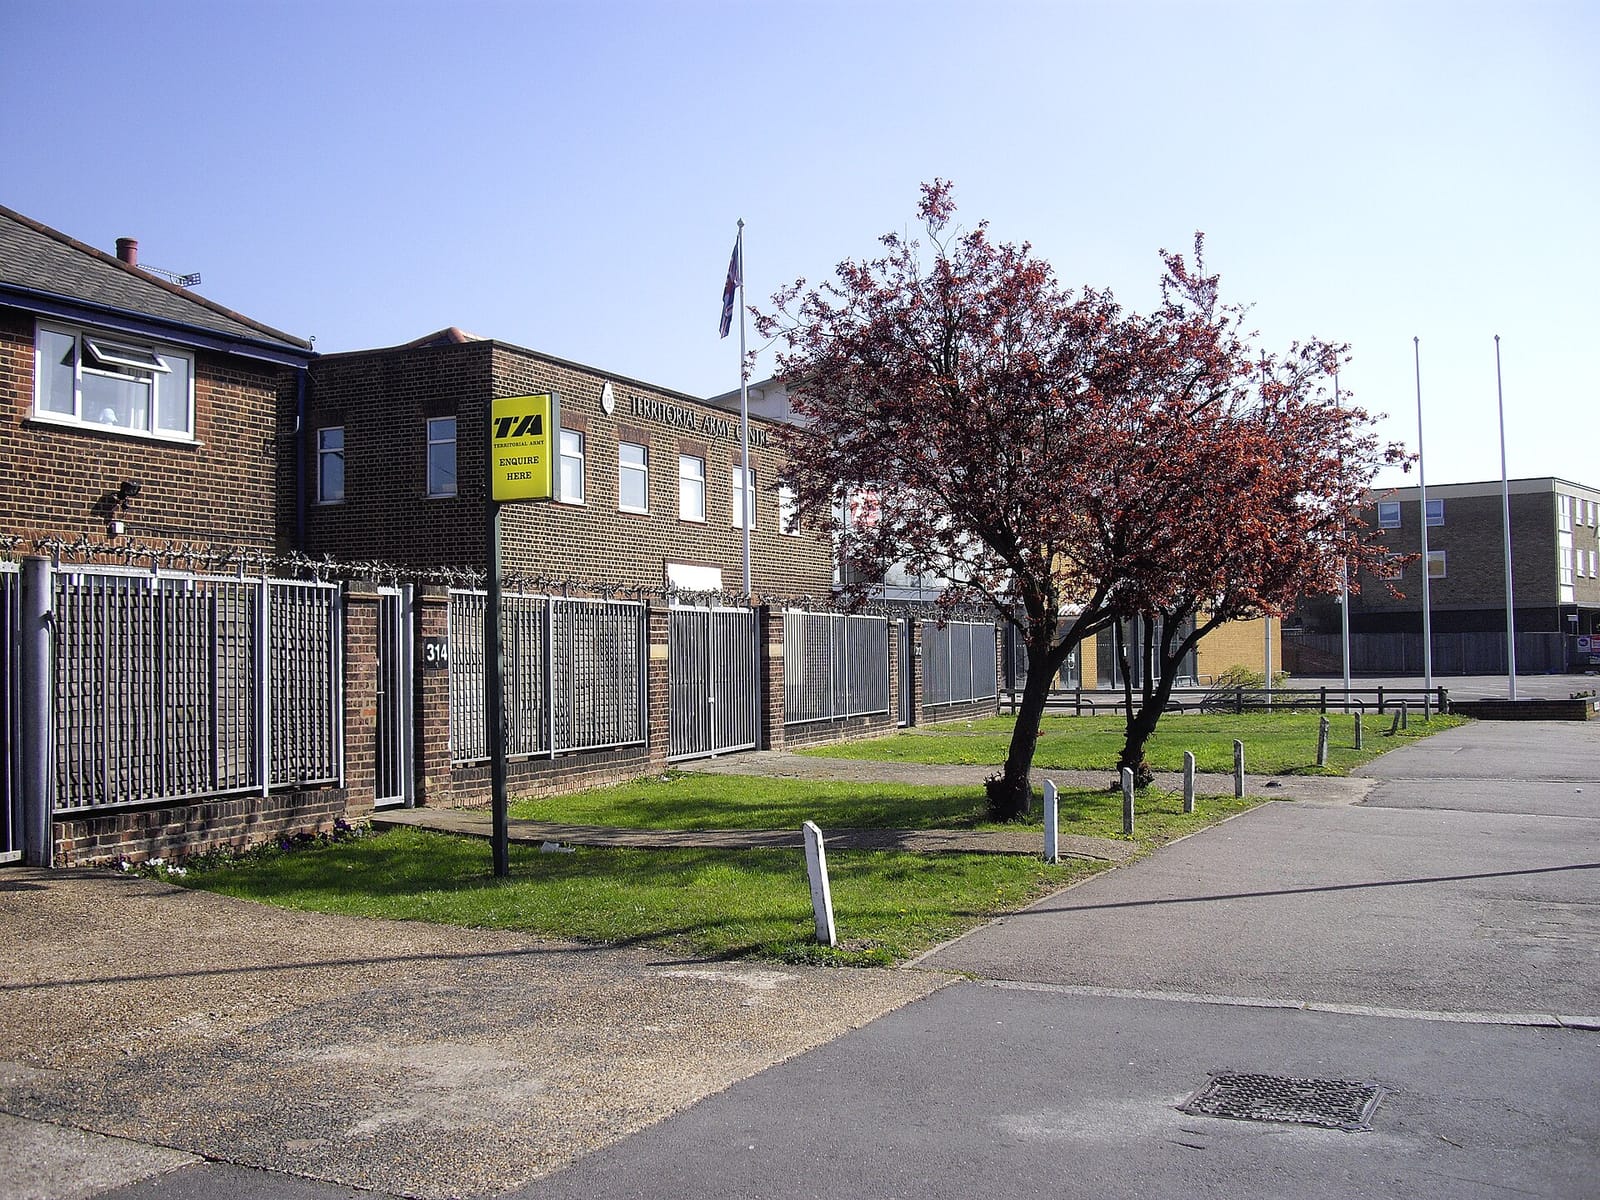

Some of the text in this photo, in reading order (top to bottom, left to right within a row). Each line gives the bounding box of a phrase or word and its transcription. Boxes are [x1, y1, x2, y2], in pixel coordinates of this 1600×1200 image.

[630, 394, 697, 429] TERRITORIAL
[702, 416, 730, 437] ARMY
[494, 414, 542, 438] TA
[499, 456, 539, 467] ENQUIRE
[507, 471, 532, 480] HERE
[426, 643, 447, 661] 314
